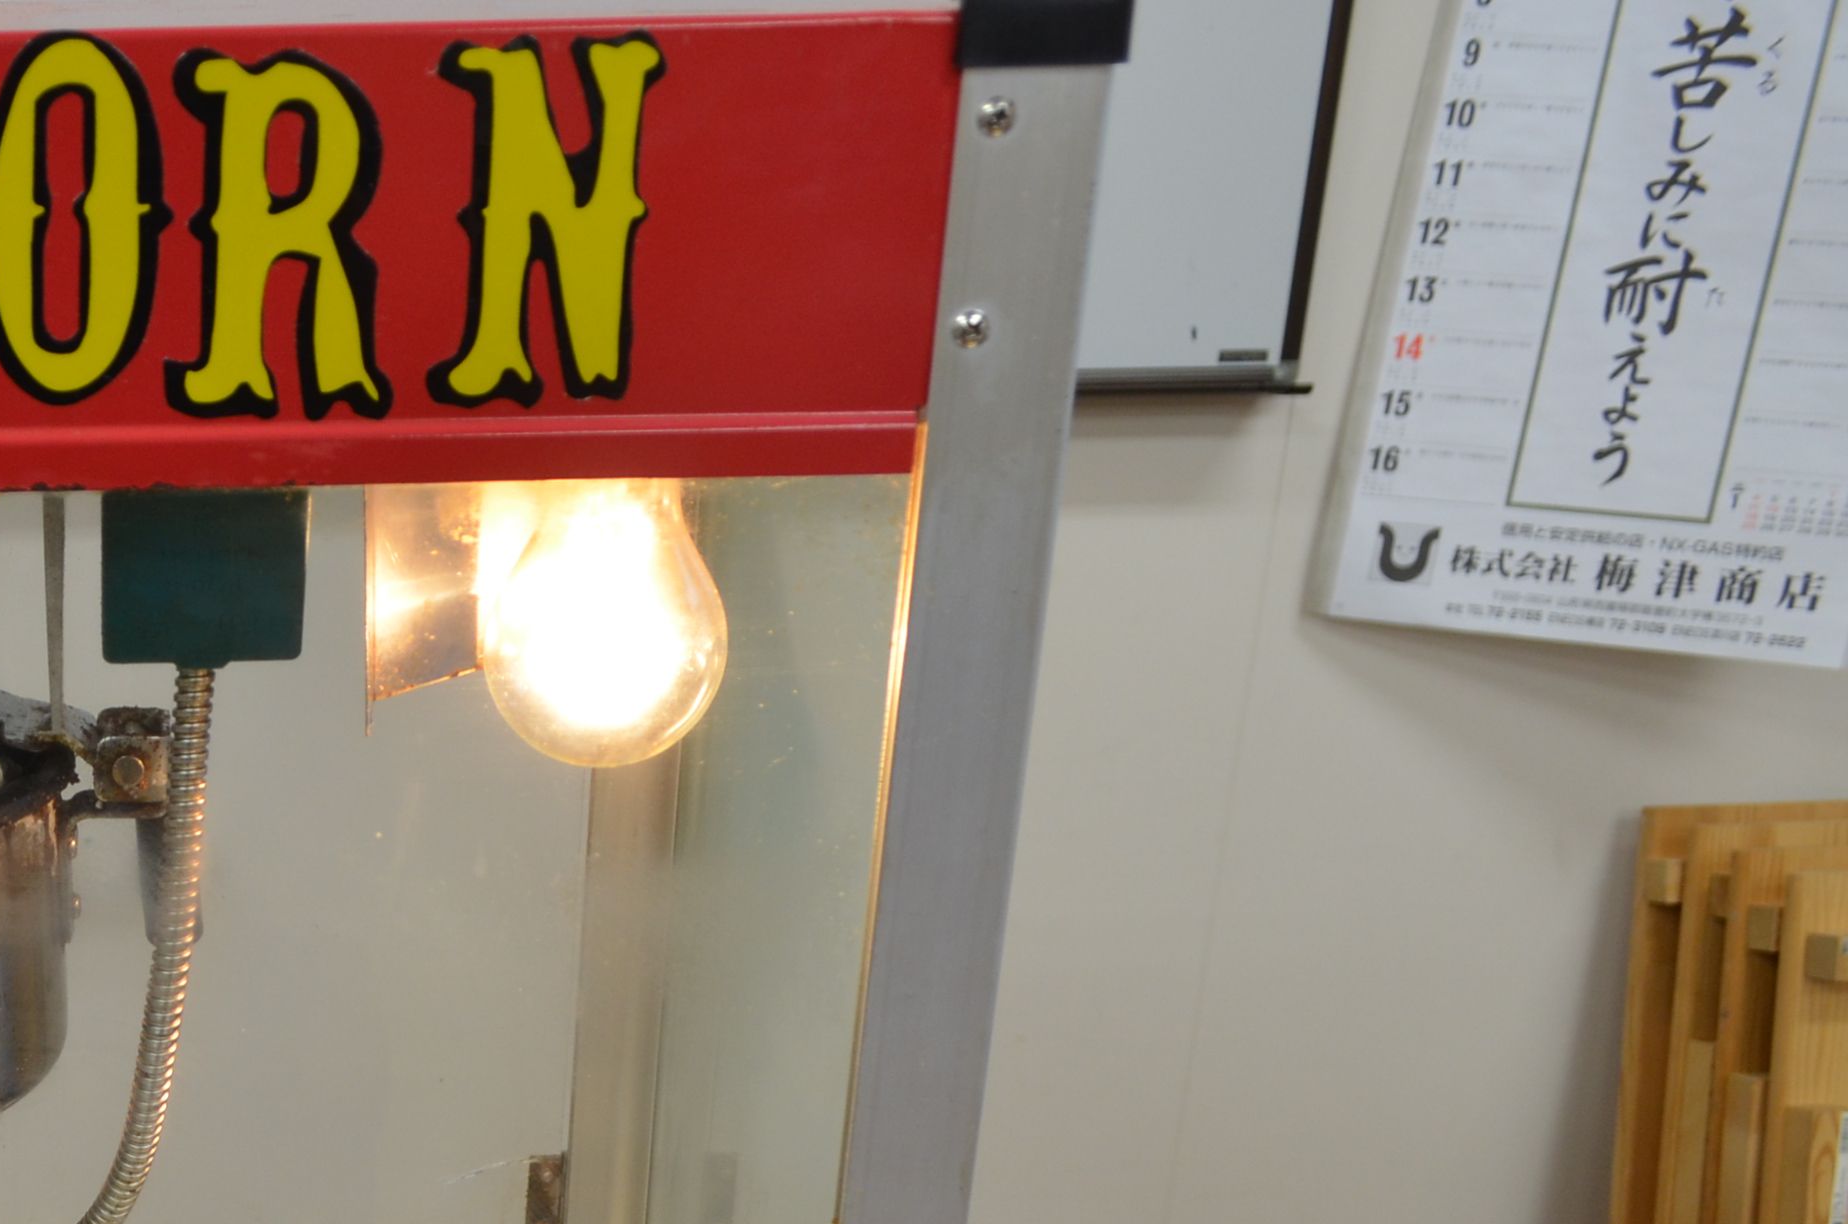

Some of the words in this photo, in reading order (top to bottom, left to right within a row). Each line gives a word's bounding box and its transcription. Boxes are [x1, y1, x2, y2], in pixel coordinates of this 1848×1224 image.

[1463, 38, 1481, 67] 9
[1445, 99, 1476, 128] 10
[1433, 159, 1463, 187] 11
[1419, 217, 1450, 246] 12
[1593, 5, 1758, 487] 苦しみに耐えよう
[1406, 276, 1437, 303] 13
[1394, 332, 1424, 361] 14
[1381, 390, 1412, 417] 15
[1369, 446, 1400, 473] 16
